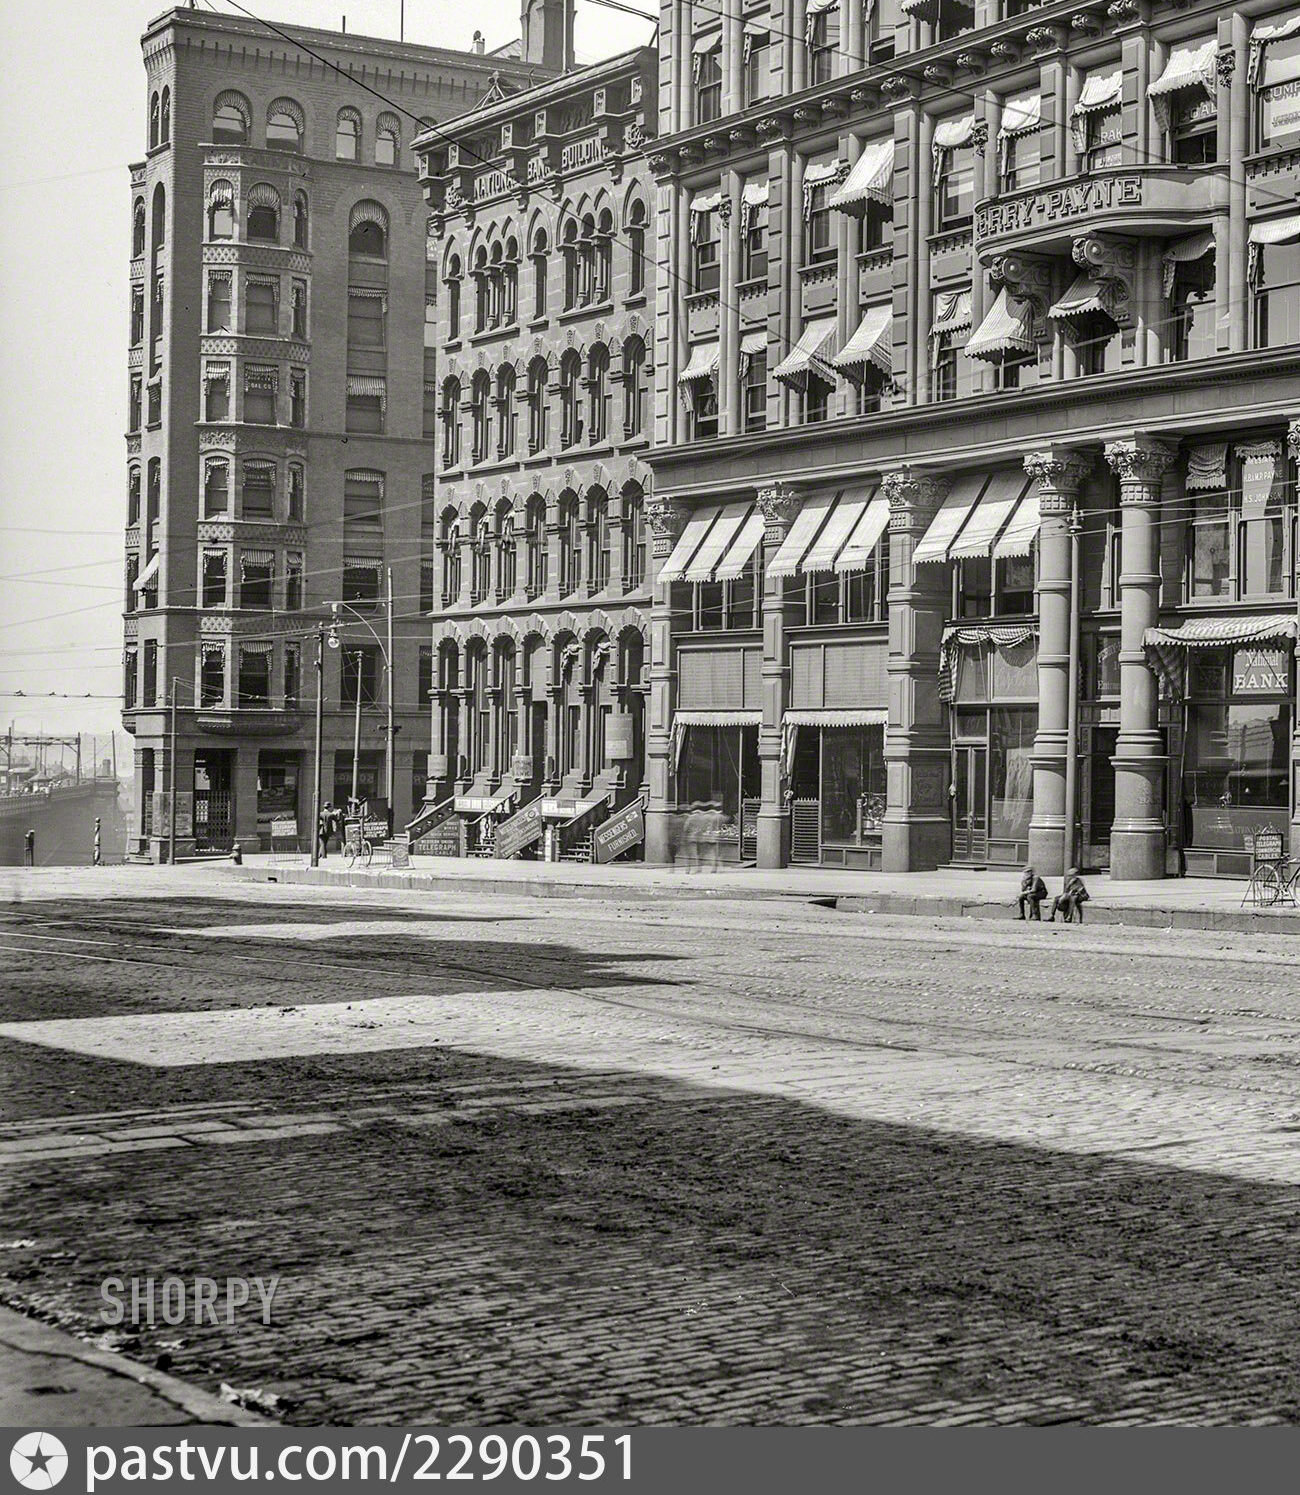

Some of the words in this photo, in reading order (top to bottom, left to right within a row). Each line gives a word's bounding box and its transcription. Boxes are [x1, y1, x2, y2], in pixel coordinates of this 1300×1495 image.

[976, 176, 1142, 237] ERRY-PAYNE
[1234, 673, 1288, 689] BANK
[419, 843, 456, 851] TELEGRAPH
